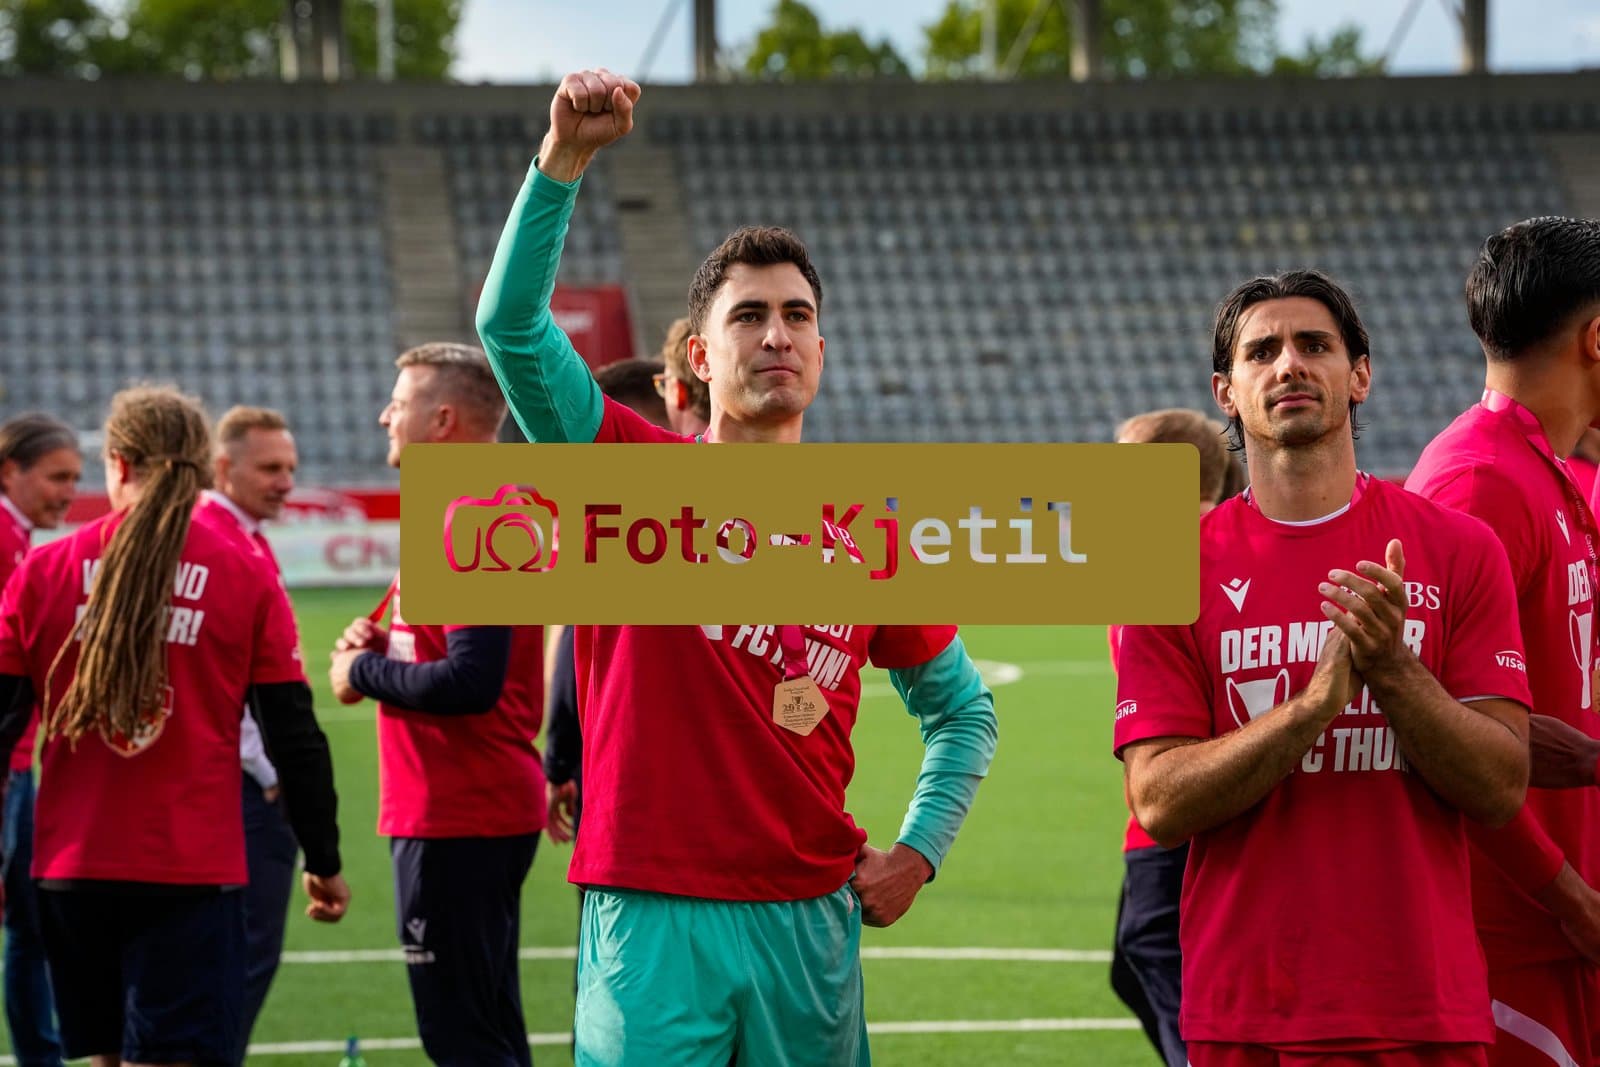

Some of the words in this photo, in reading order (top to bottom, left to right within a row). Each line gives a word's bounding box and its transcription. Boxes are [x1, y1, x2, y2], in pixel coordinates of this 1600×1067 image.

[1402, 581, 1441, 610] BS
[770, 637, 851, 691] UN!
[1220, 624, 1283, 675] DER
[1290, 730, 1326, 773] C
